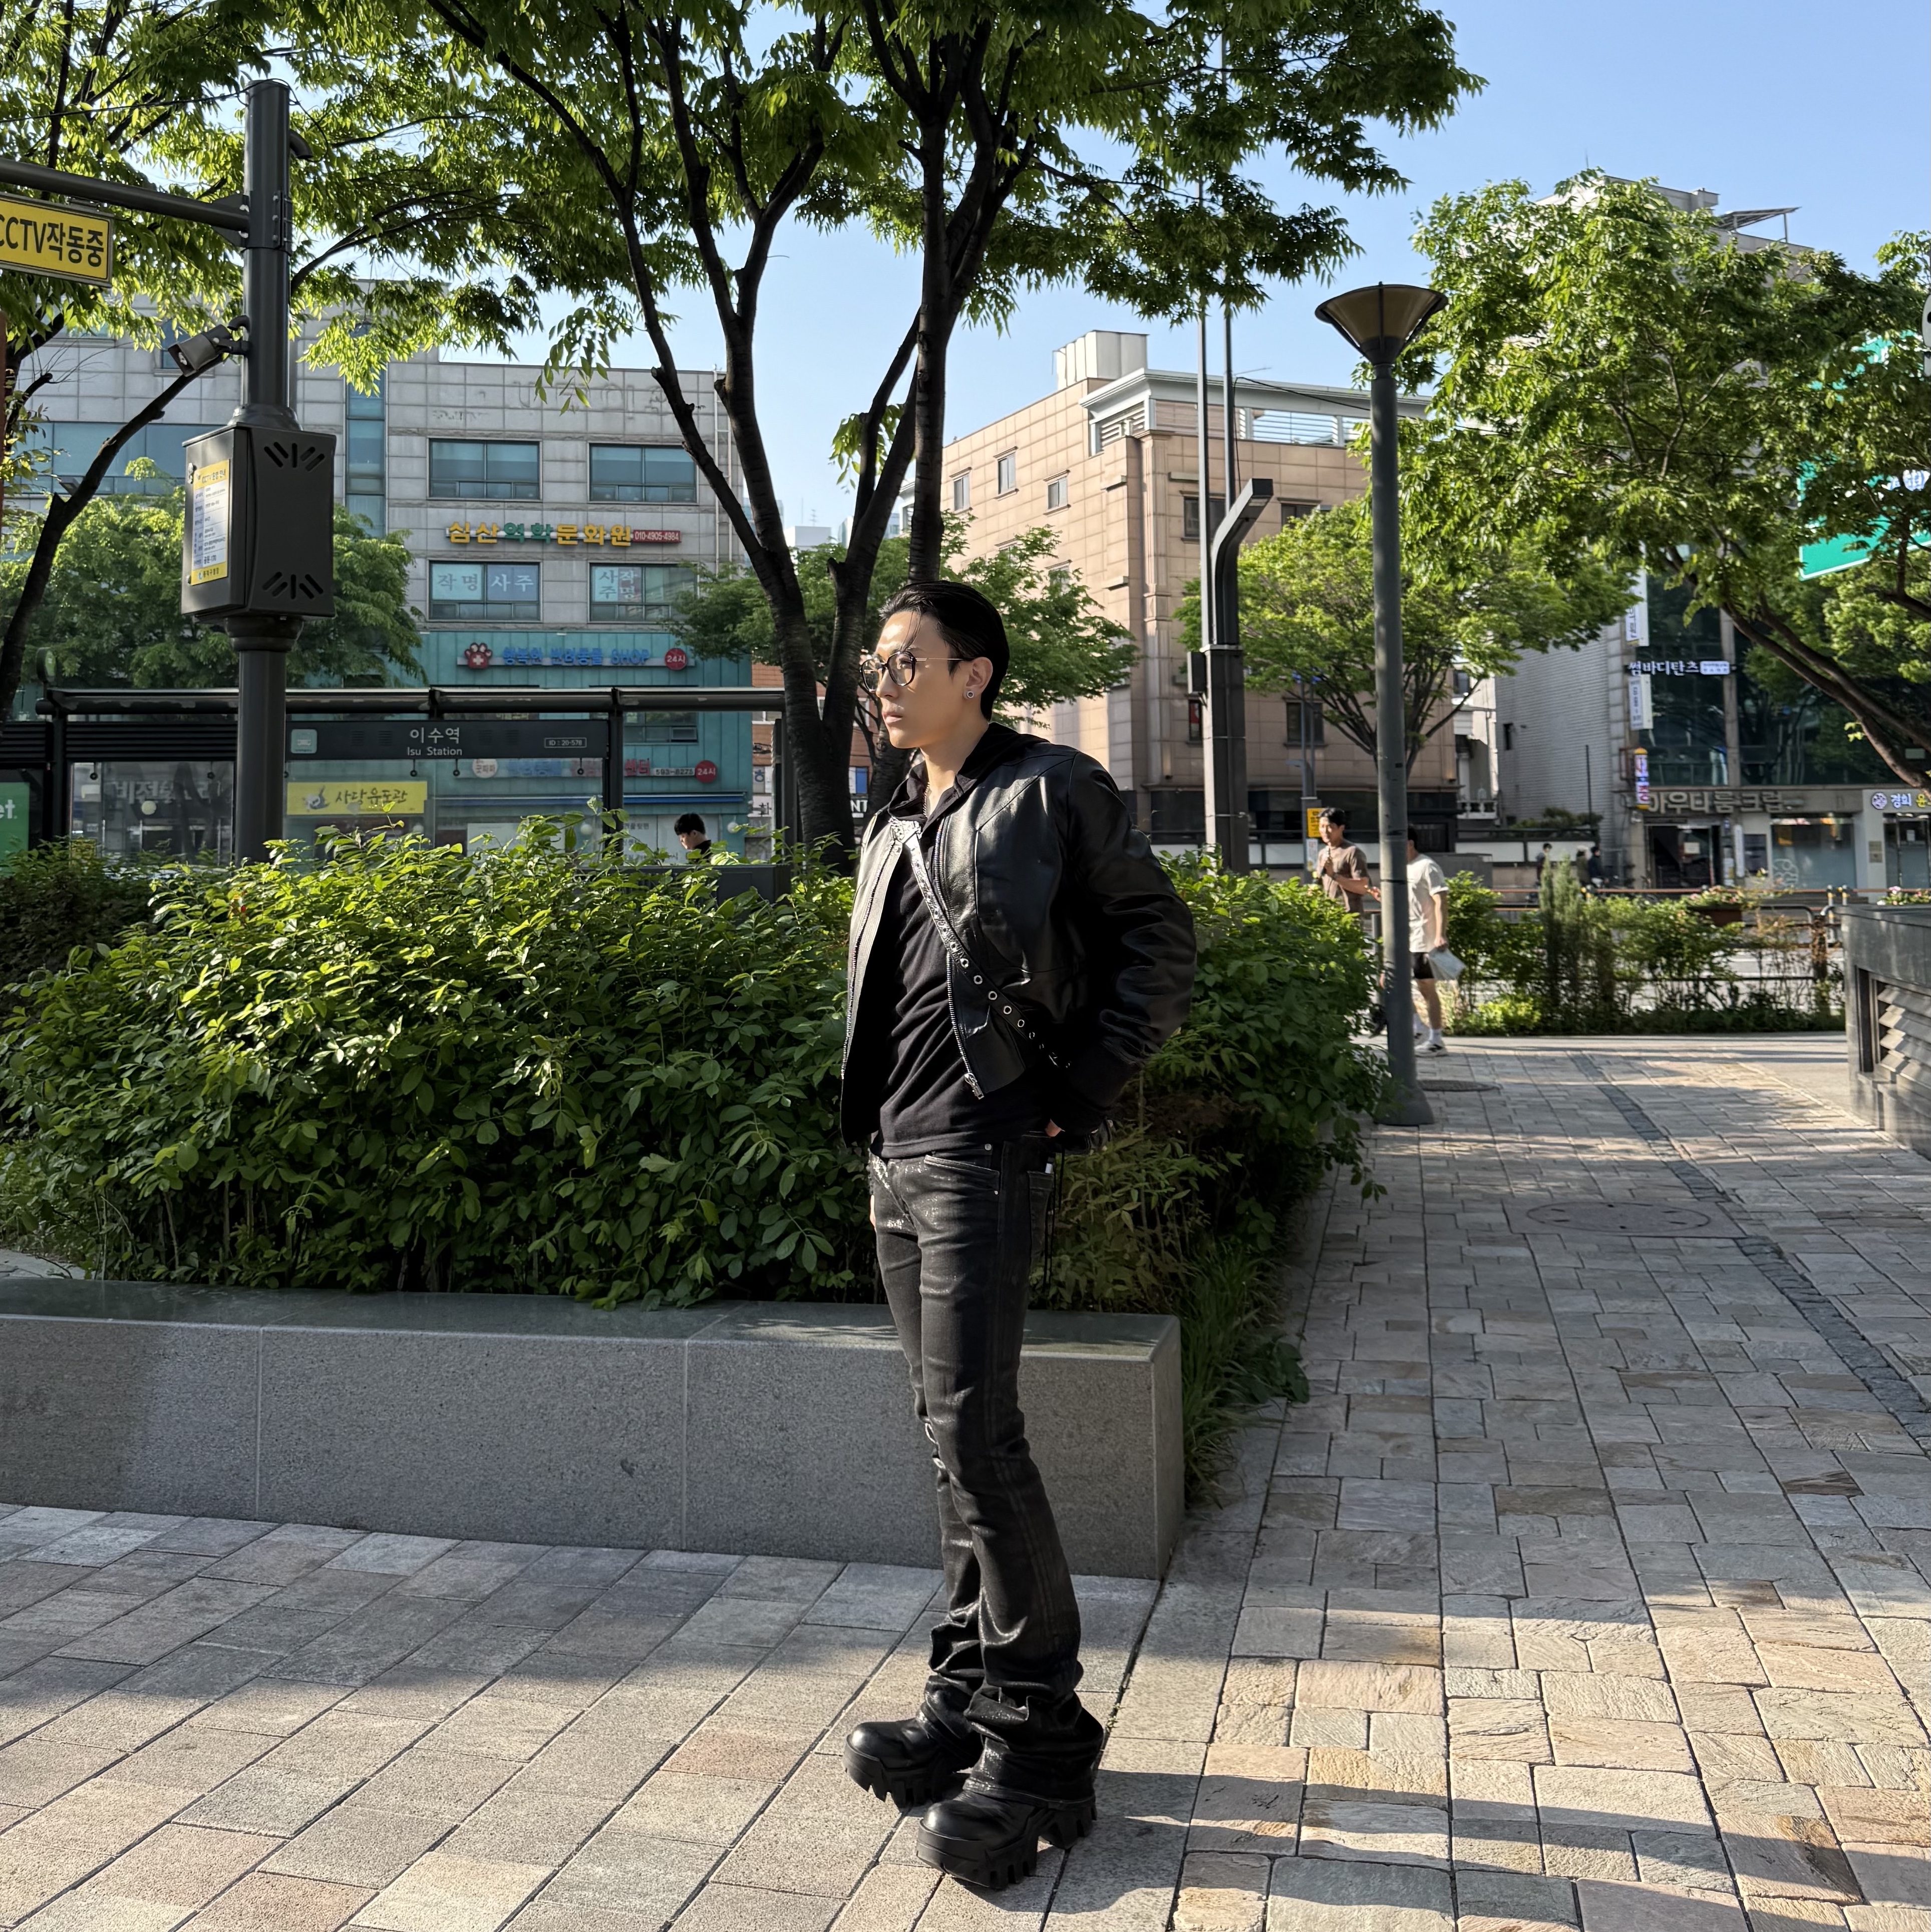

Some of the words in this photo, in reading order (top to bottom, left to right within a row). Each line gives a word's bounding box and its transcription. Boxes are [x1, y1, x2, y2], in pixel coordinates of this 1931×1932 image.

[437, 573, 478, 592] 작명
[490, 573, 534, 592] 사주
[610, 649, 650, 665] SHOP
[667, 655, 686, 664] 24시
[410, 727, 460, 744] 이수역
[407, 747, 421, 756] Isu
[427, 747, 462, 756] Station
[698, 767, 716, 776] 24시
[336, 787, 408, 805] 사당유도관
[1890, 793, 1912, 808] 경희
